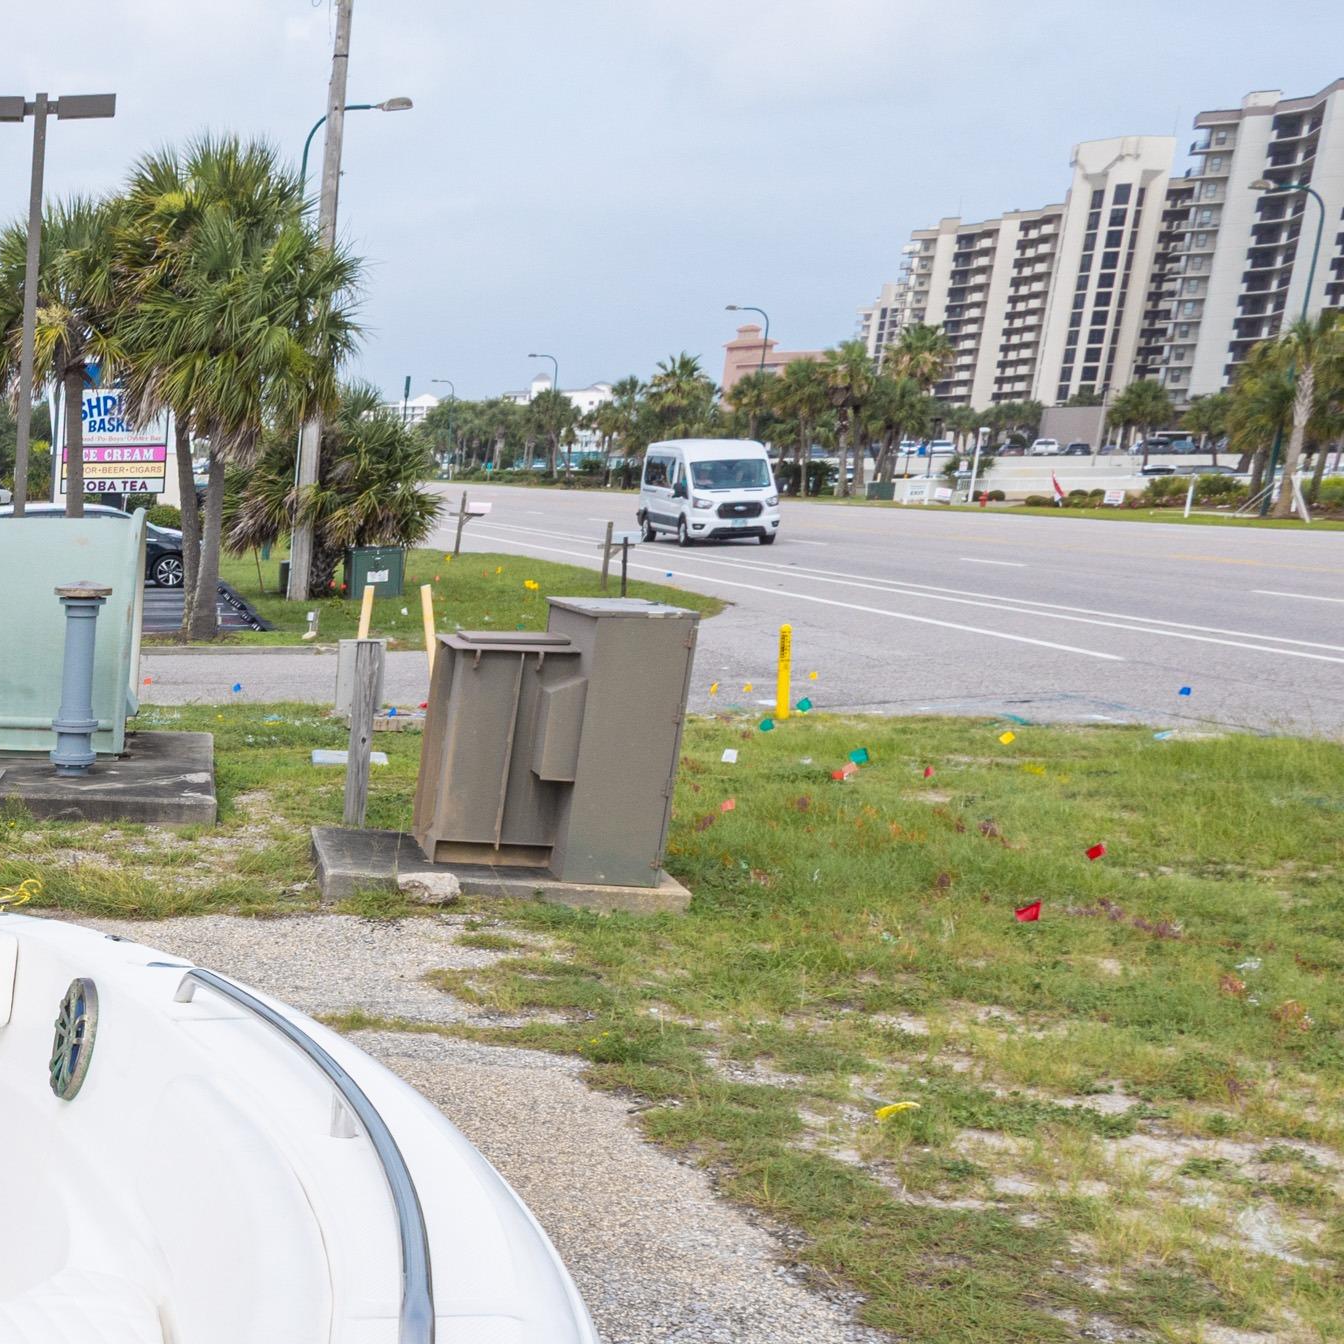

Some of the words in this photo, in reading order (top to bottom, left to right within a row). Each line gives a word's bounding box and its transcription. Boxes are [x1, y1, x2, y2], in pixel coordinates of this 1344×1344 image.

[88, 417, 133, 433] BASKE
[82, 448, 98, 461] CE
[104, 447, 154, 461] CREAM
[102, 466, 126, 474] BEER
[129, 465, 162, 474] CIGARS
[82, 480, 116, 492] OBA
[121, 480, 148, 491] TEA
